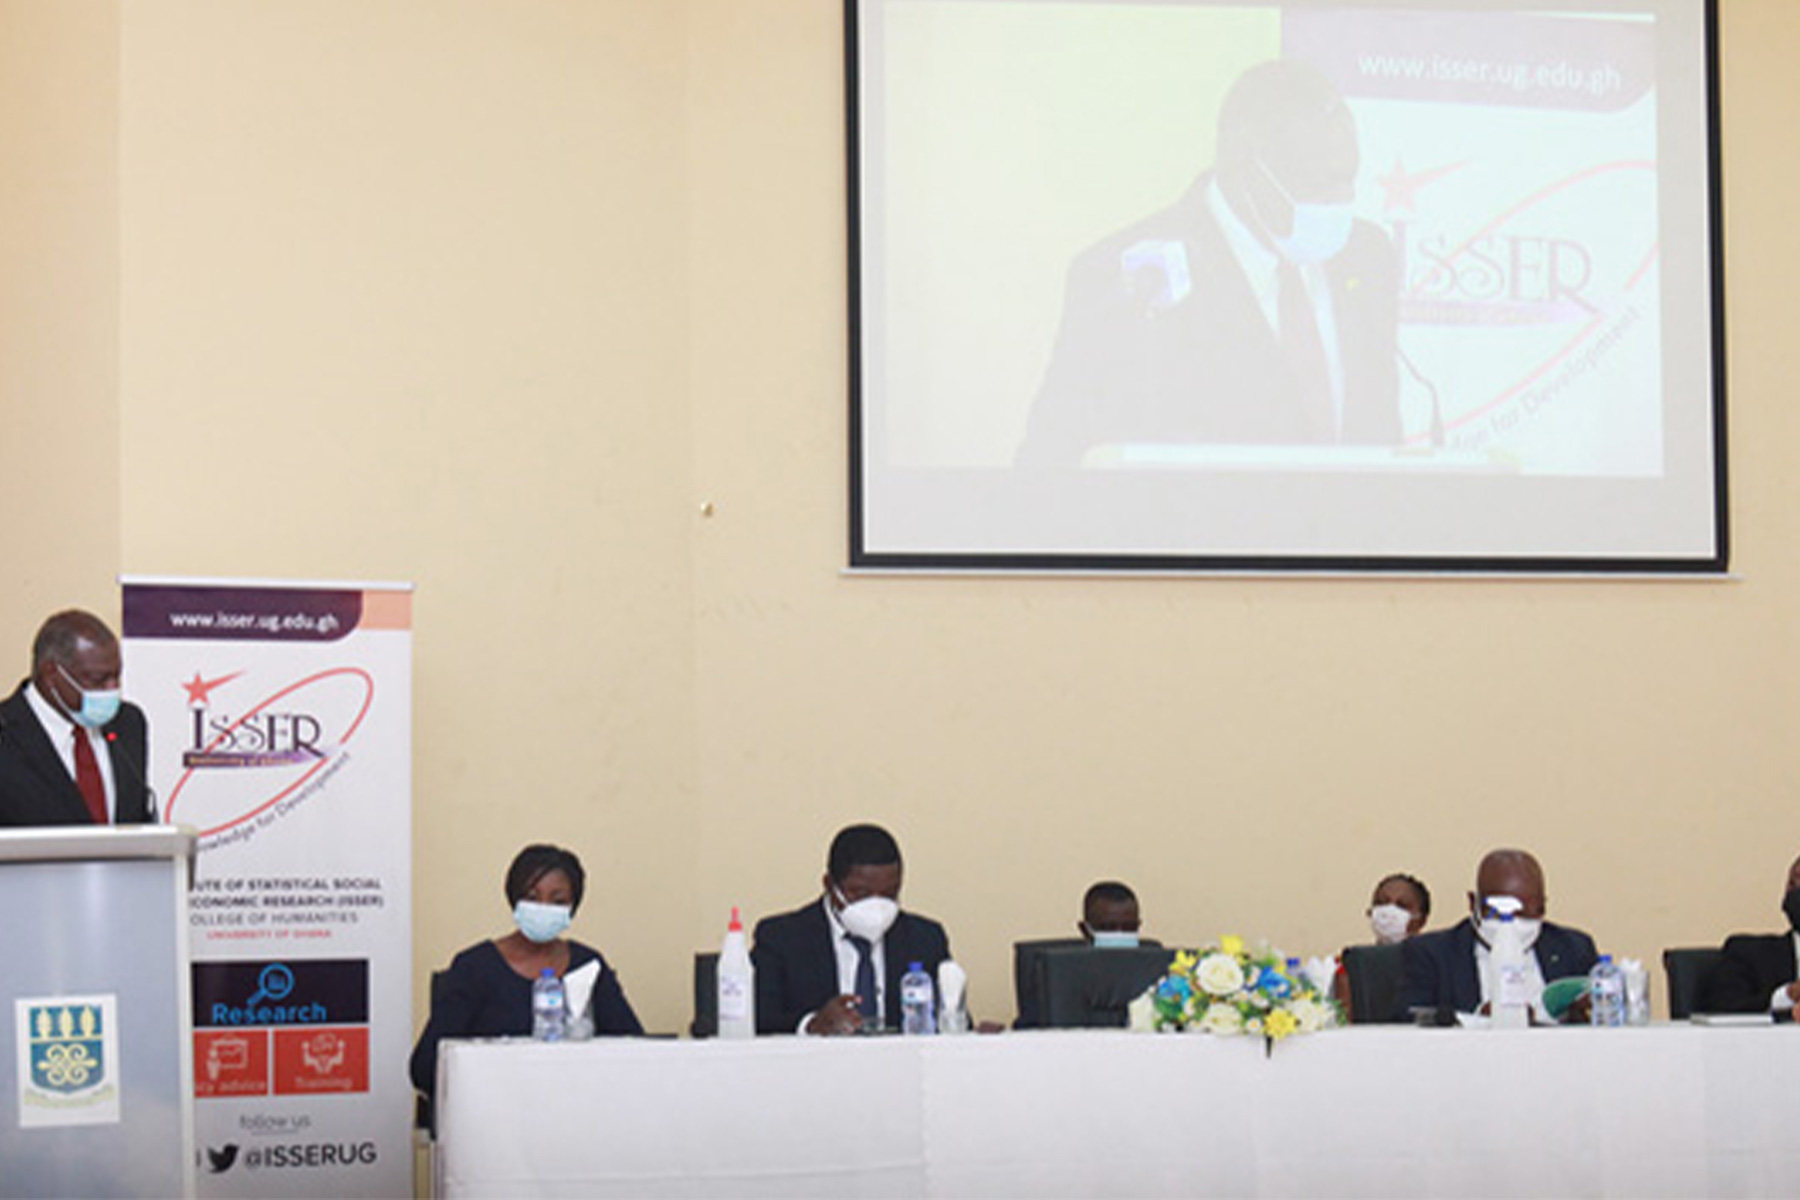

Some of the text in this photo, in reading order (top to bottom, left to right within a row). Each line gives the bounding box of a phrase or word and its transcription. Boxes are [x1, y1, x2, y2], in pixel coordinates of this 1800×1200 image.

[1358, 53, 1622, 96] www.isser.ug.edu.gh
[170, 612, 338, 632] www.isser.ug.edu.gh
[193, 708, 324, 758] ISSER
[225, 878, 243, 891] OF
[247, 877, 329, 891] STATISTICAL
[333, 876, 382, 890] SOCIAL
[262, 895, 334, 907] RESEARCH
[190, 910, 359, 926] OLLEGE OF HUMANITIES
[212, 1002, 327, 1025] Research
[295, 1077, 352, 1090] Training
[239, 1114, 311, 1130] follow us
[245, 1142, 377, 1169] @ISSERUG
